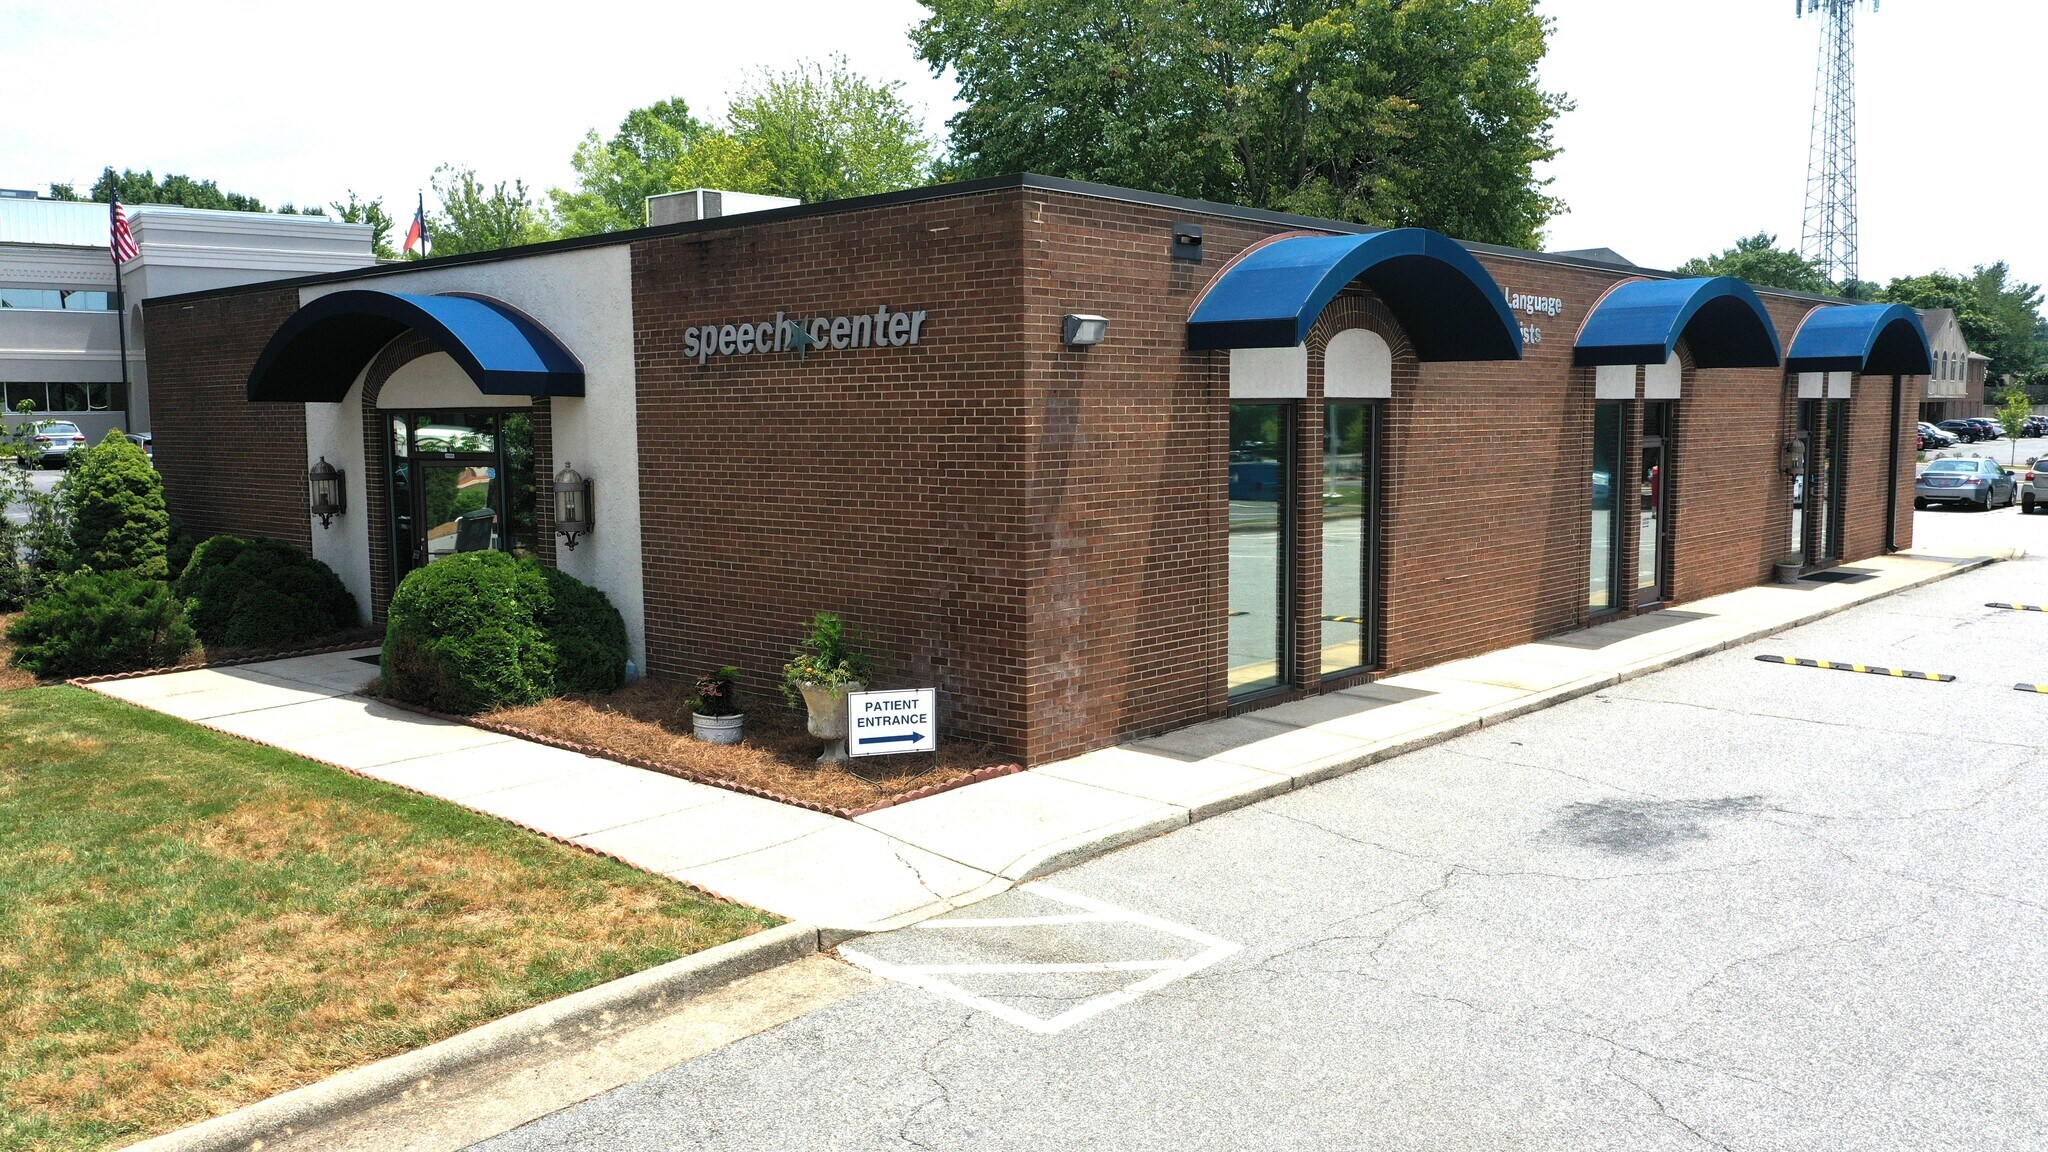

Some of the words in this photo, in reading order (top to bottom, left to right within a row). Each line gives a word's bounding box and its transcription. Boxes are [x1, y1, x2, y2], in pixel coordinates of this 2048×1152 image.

[1504, 287, 1562, 317] Language
[683, 311, 791, 364] speech
[810, 304, 927, 350] center
[865, 699, 918, 712] PATIENT
[858, 713, 926, 727] ENTRANCE
